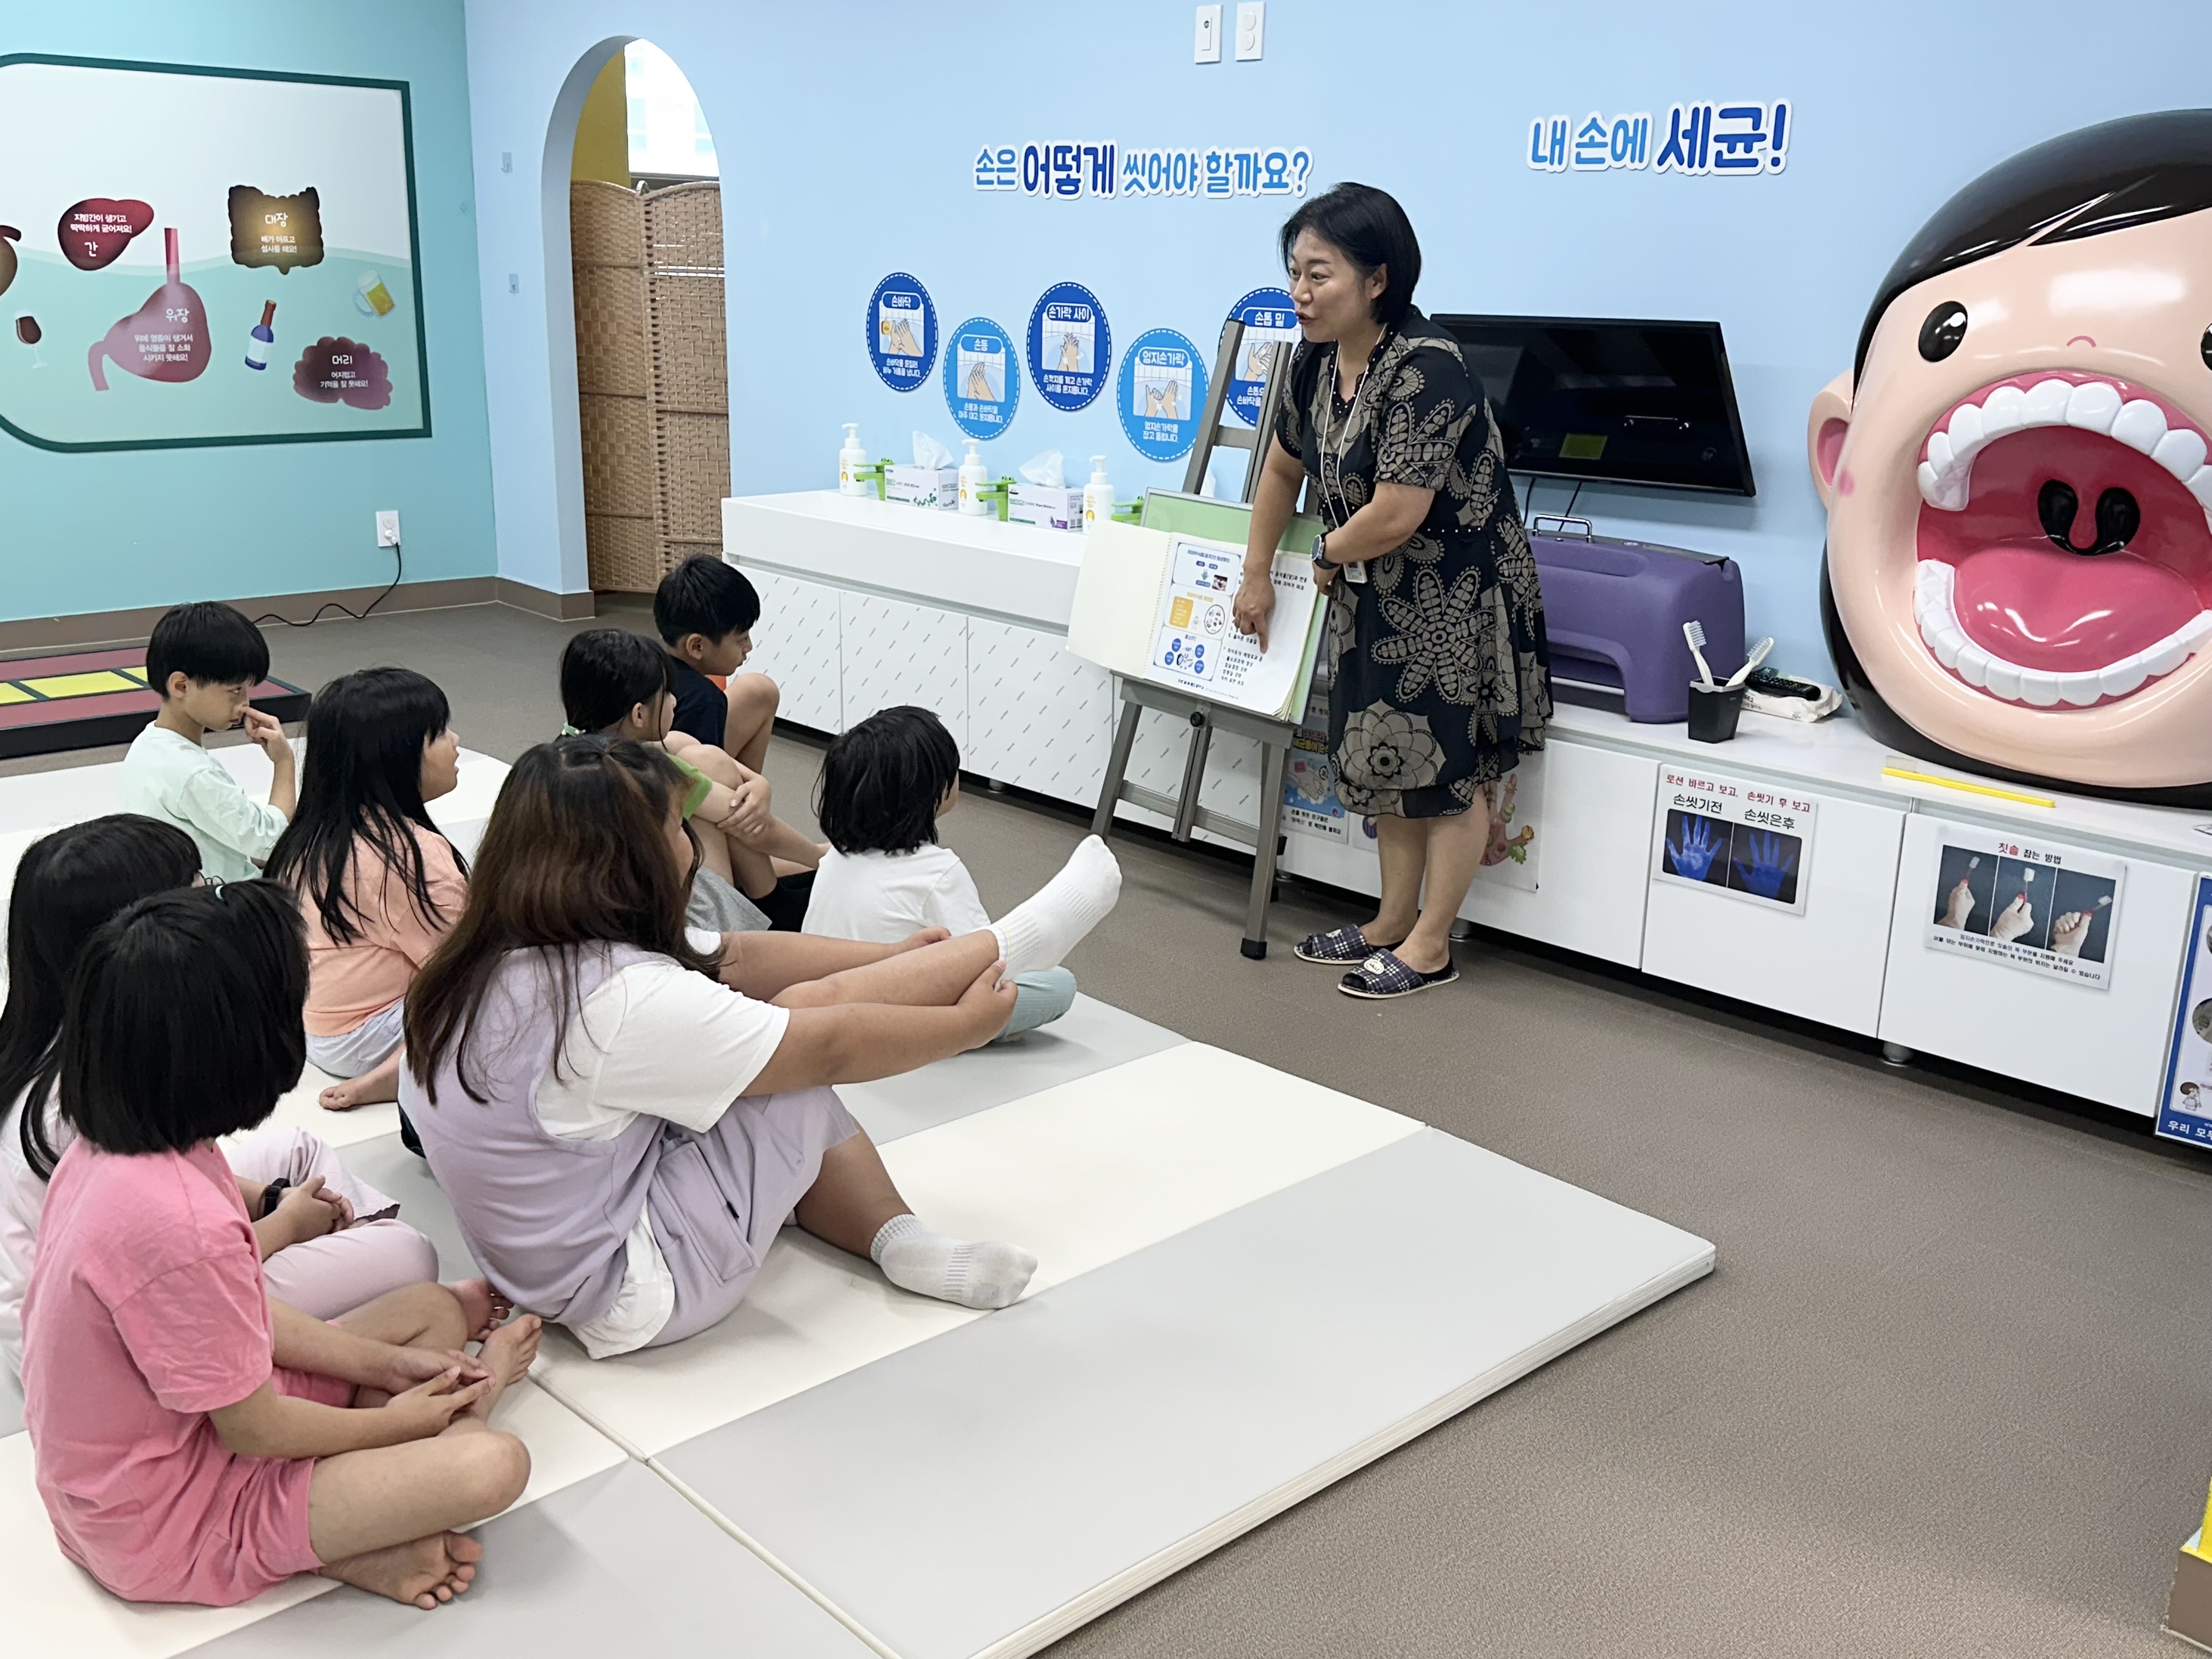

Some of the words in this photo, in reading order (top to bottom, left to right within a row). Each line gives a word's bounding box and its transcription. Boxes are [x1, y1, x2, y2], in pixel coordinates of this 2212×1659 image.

[1531, 120, 1566, 165] 내
[1576, 117, 1647, 164] 손에
[1657, 104, 1786, 168] 세균!
[975, 149, 1017, 186] 손은
[1024, 144, 1115, 195] 어떻게
[1123, 153, 1199, 192] 씻어야
[1206, 151, 1310, 193] 할까요?
[265, 212, 289, 228] 대장
[84, 241, 99, 257] 간
[891, 295, 911, 308] 손바닥
[166, 308, 190, 323] 위장
[1048, 306, 1072, 320] 손가락
[1073, 307, 1090, 320] 사이
[1255, 311, 1273, 326] 손톱
[974, 338, 988, 352] 손등
[332, 354, 353, 365] 머리
[1142, 350, 1185, 366] 엄지손가락
[1144, 421, 1179, 433] 엄지손가락을
[1666, 774, 1684, 786] 로션
[1688, 778, 1714, 792] 바르고
[1747, 791, 1774, 805] 손씻기
[1779, 797, 1787, 808] 후
[1792, 800, 1811, 813] 보고
[1673, 793, 1722, 815] 손씻기전
[1744, 808, 1795, 830] 손씻은후
[1999, 843, 2019, 856] 칫솔
[2024, 849, 2040, 860] 잡는
[2045, 854, 2061, 865] 방법
[2168, 1120, 2190, 1135] 우리
